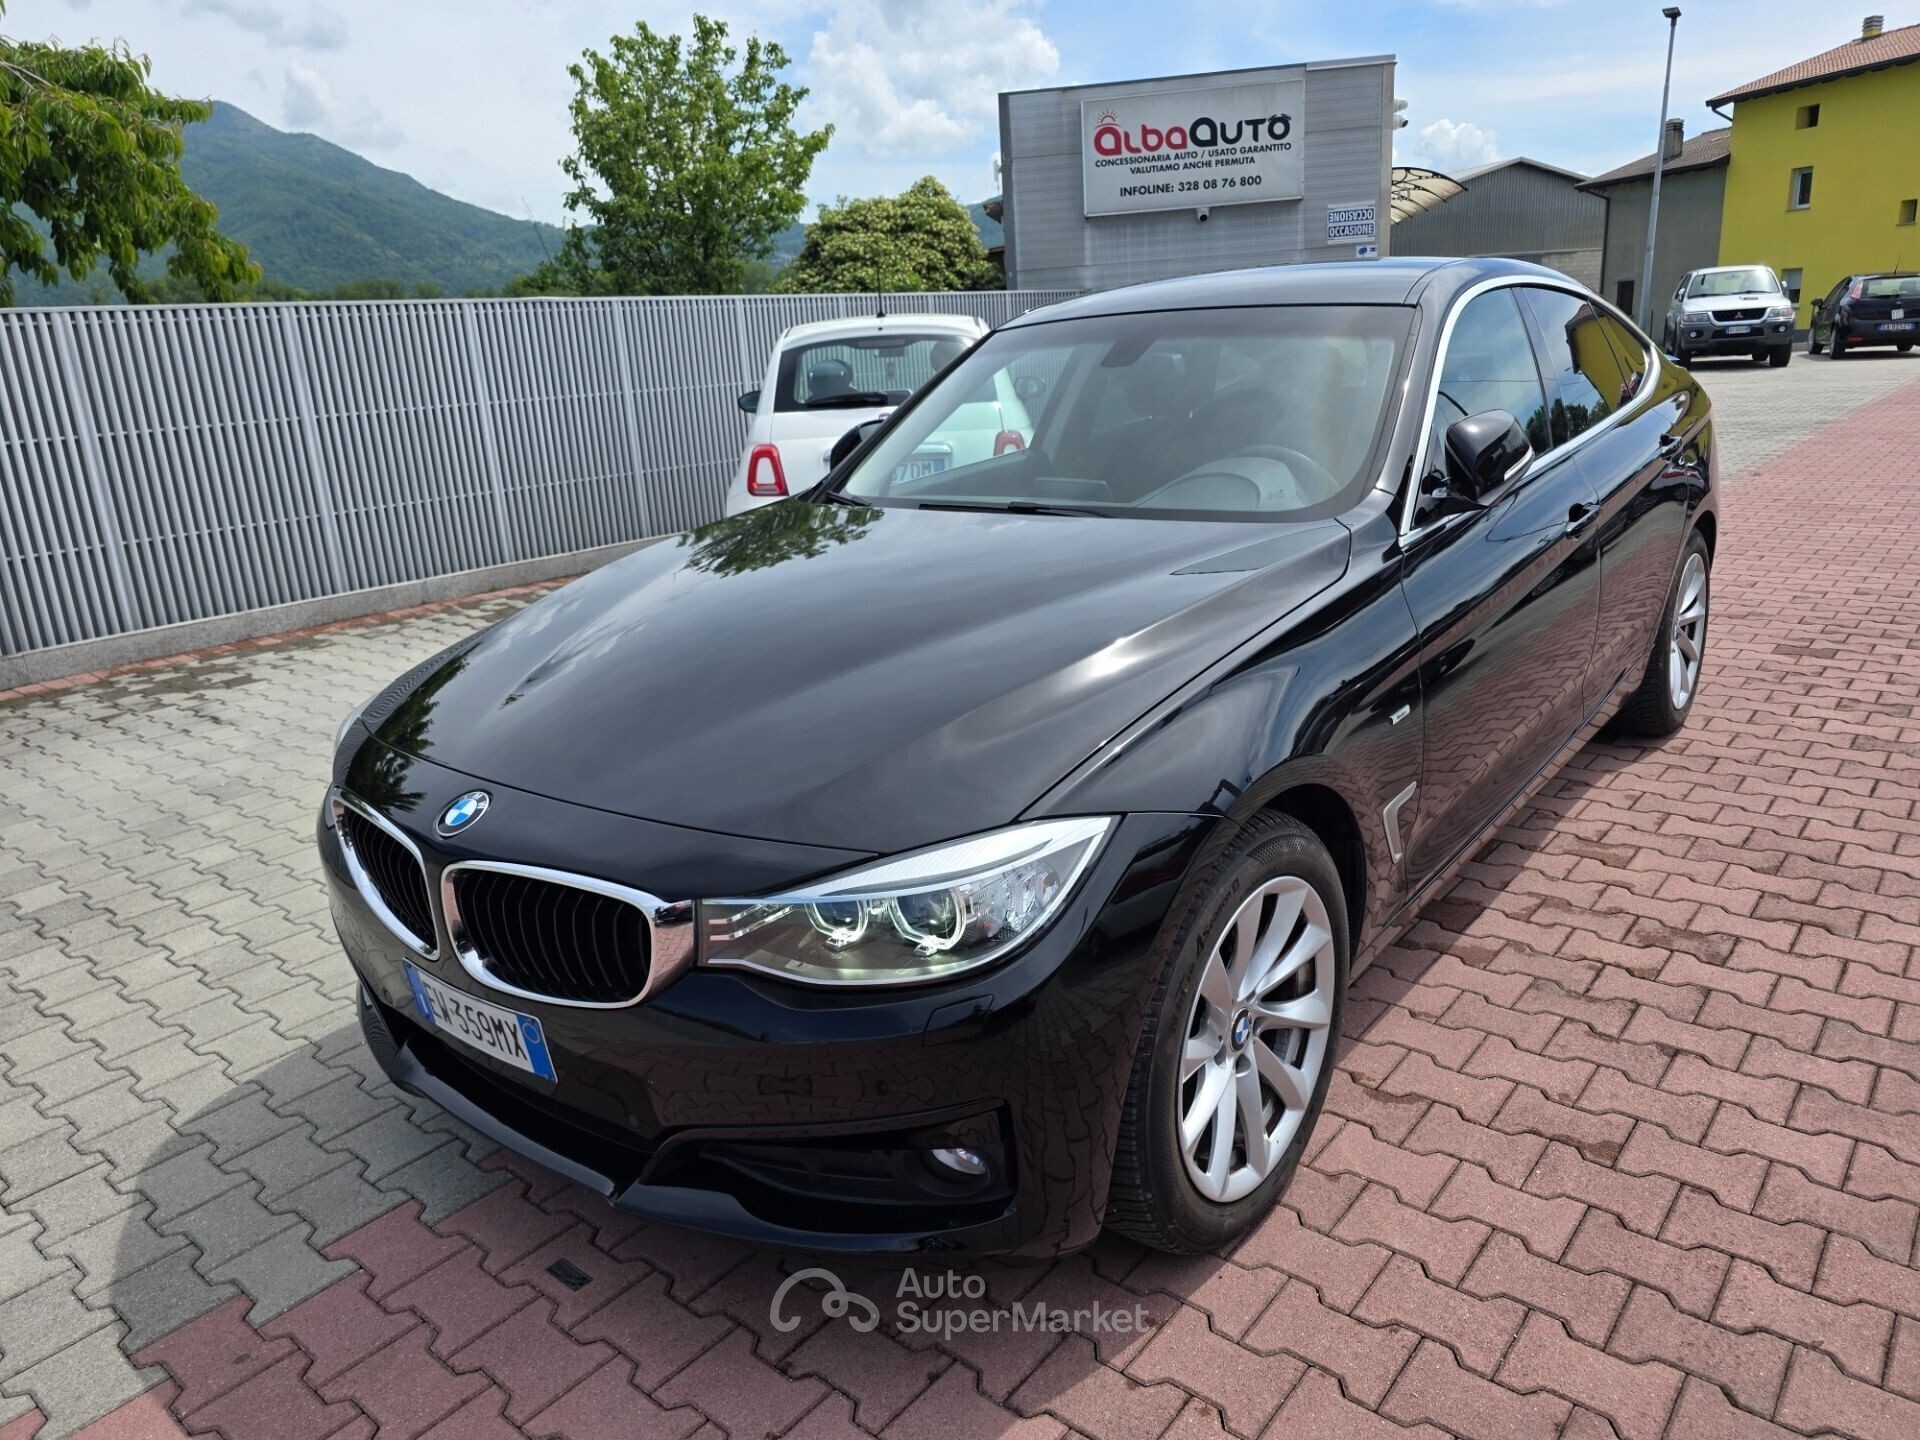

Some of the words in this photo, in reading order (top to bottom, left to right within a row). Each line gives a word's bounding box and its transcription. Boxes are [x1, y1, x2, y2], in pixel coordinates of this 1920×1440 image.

[1095, 153, 1171, 168] CONCESSIONARIA
[1174, 151, 1198, 161] AUTO
[1208, 147, 1237, 158] USATO
[1240, 142, 1292, 155] GARANTITO
[1130, 163, 1180, 175] VALUTIAMO
[1182, 160, 1213, 170] ANCHE
[1215, 156, 1255, 167] PERMUTA
[1120, 183, 1174, 197] INFOLINE:
[1178, 180, 1199, 192] 328
[1203, 178, 1218, 190] 08
[1221, 177, 1236, 188] 76
[1240, 175, 1262, 187] 800
[1329, 209, 1373, 223] OCCASIONE
[1329, 224, 1374, 237] OCCASIONE
